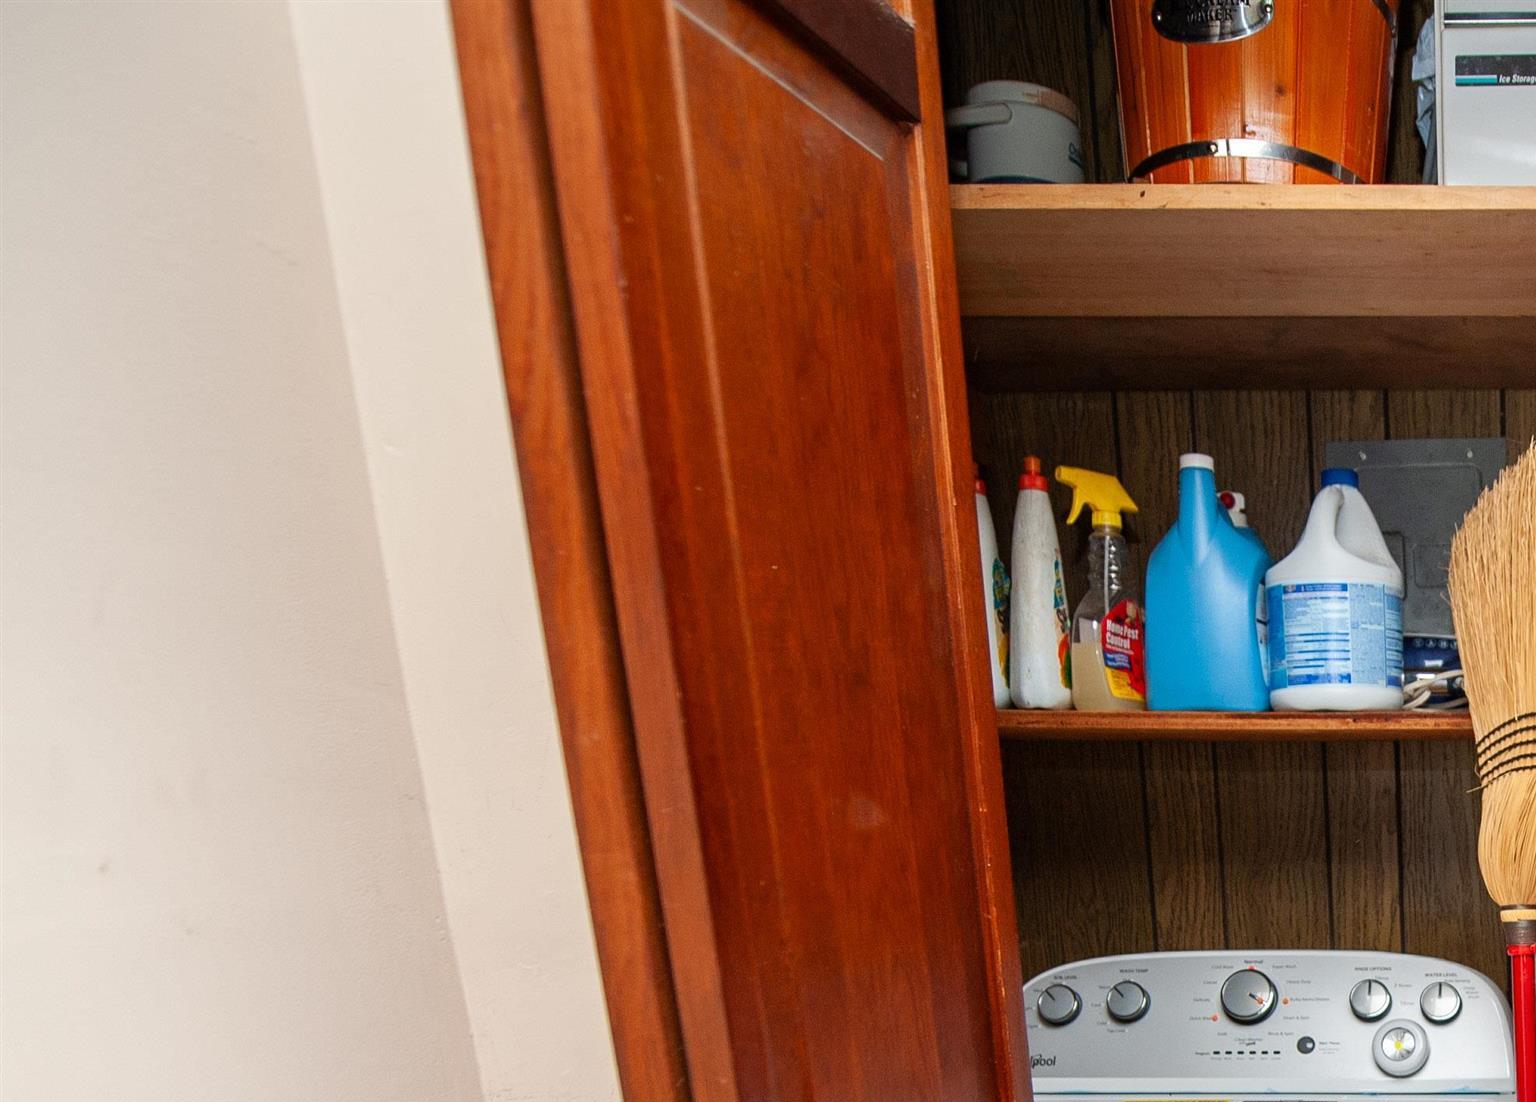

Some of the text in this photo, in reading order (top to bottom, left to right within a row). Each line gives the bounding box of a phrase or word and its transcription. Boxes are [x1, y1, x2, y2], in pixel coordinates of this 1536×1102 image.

[1185, 6, 1233, 22] MAKER
[1499, 74, 1510, 83] Ice
[1106, 619, 1139, 640] Home Pest
[1106, 631, 1131, 650] Control
